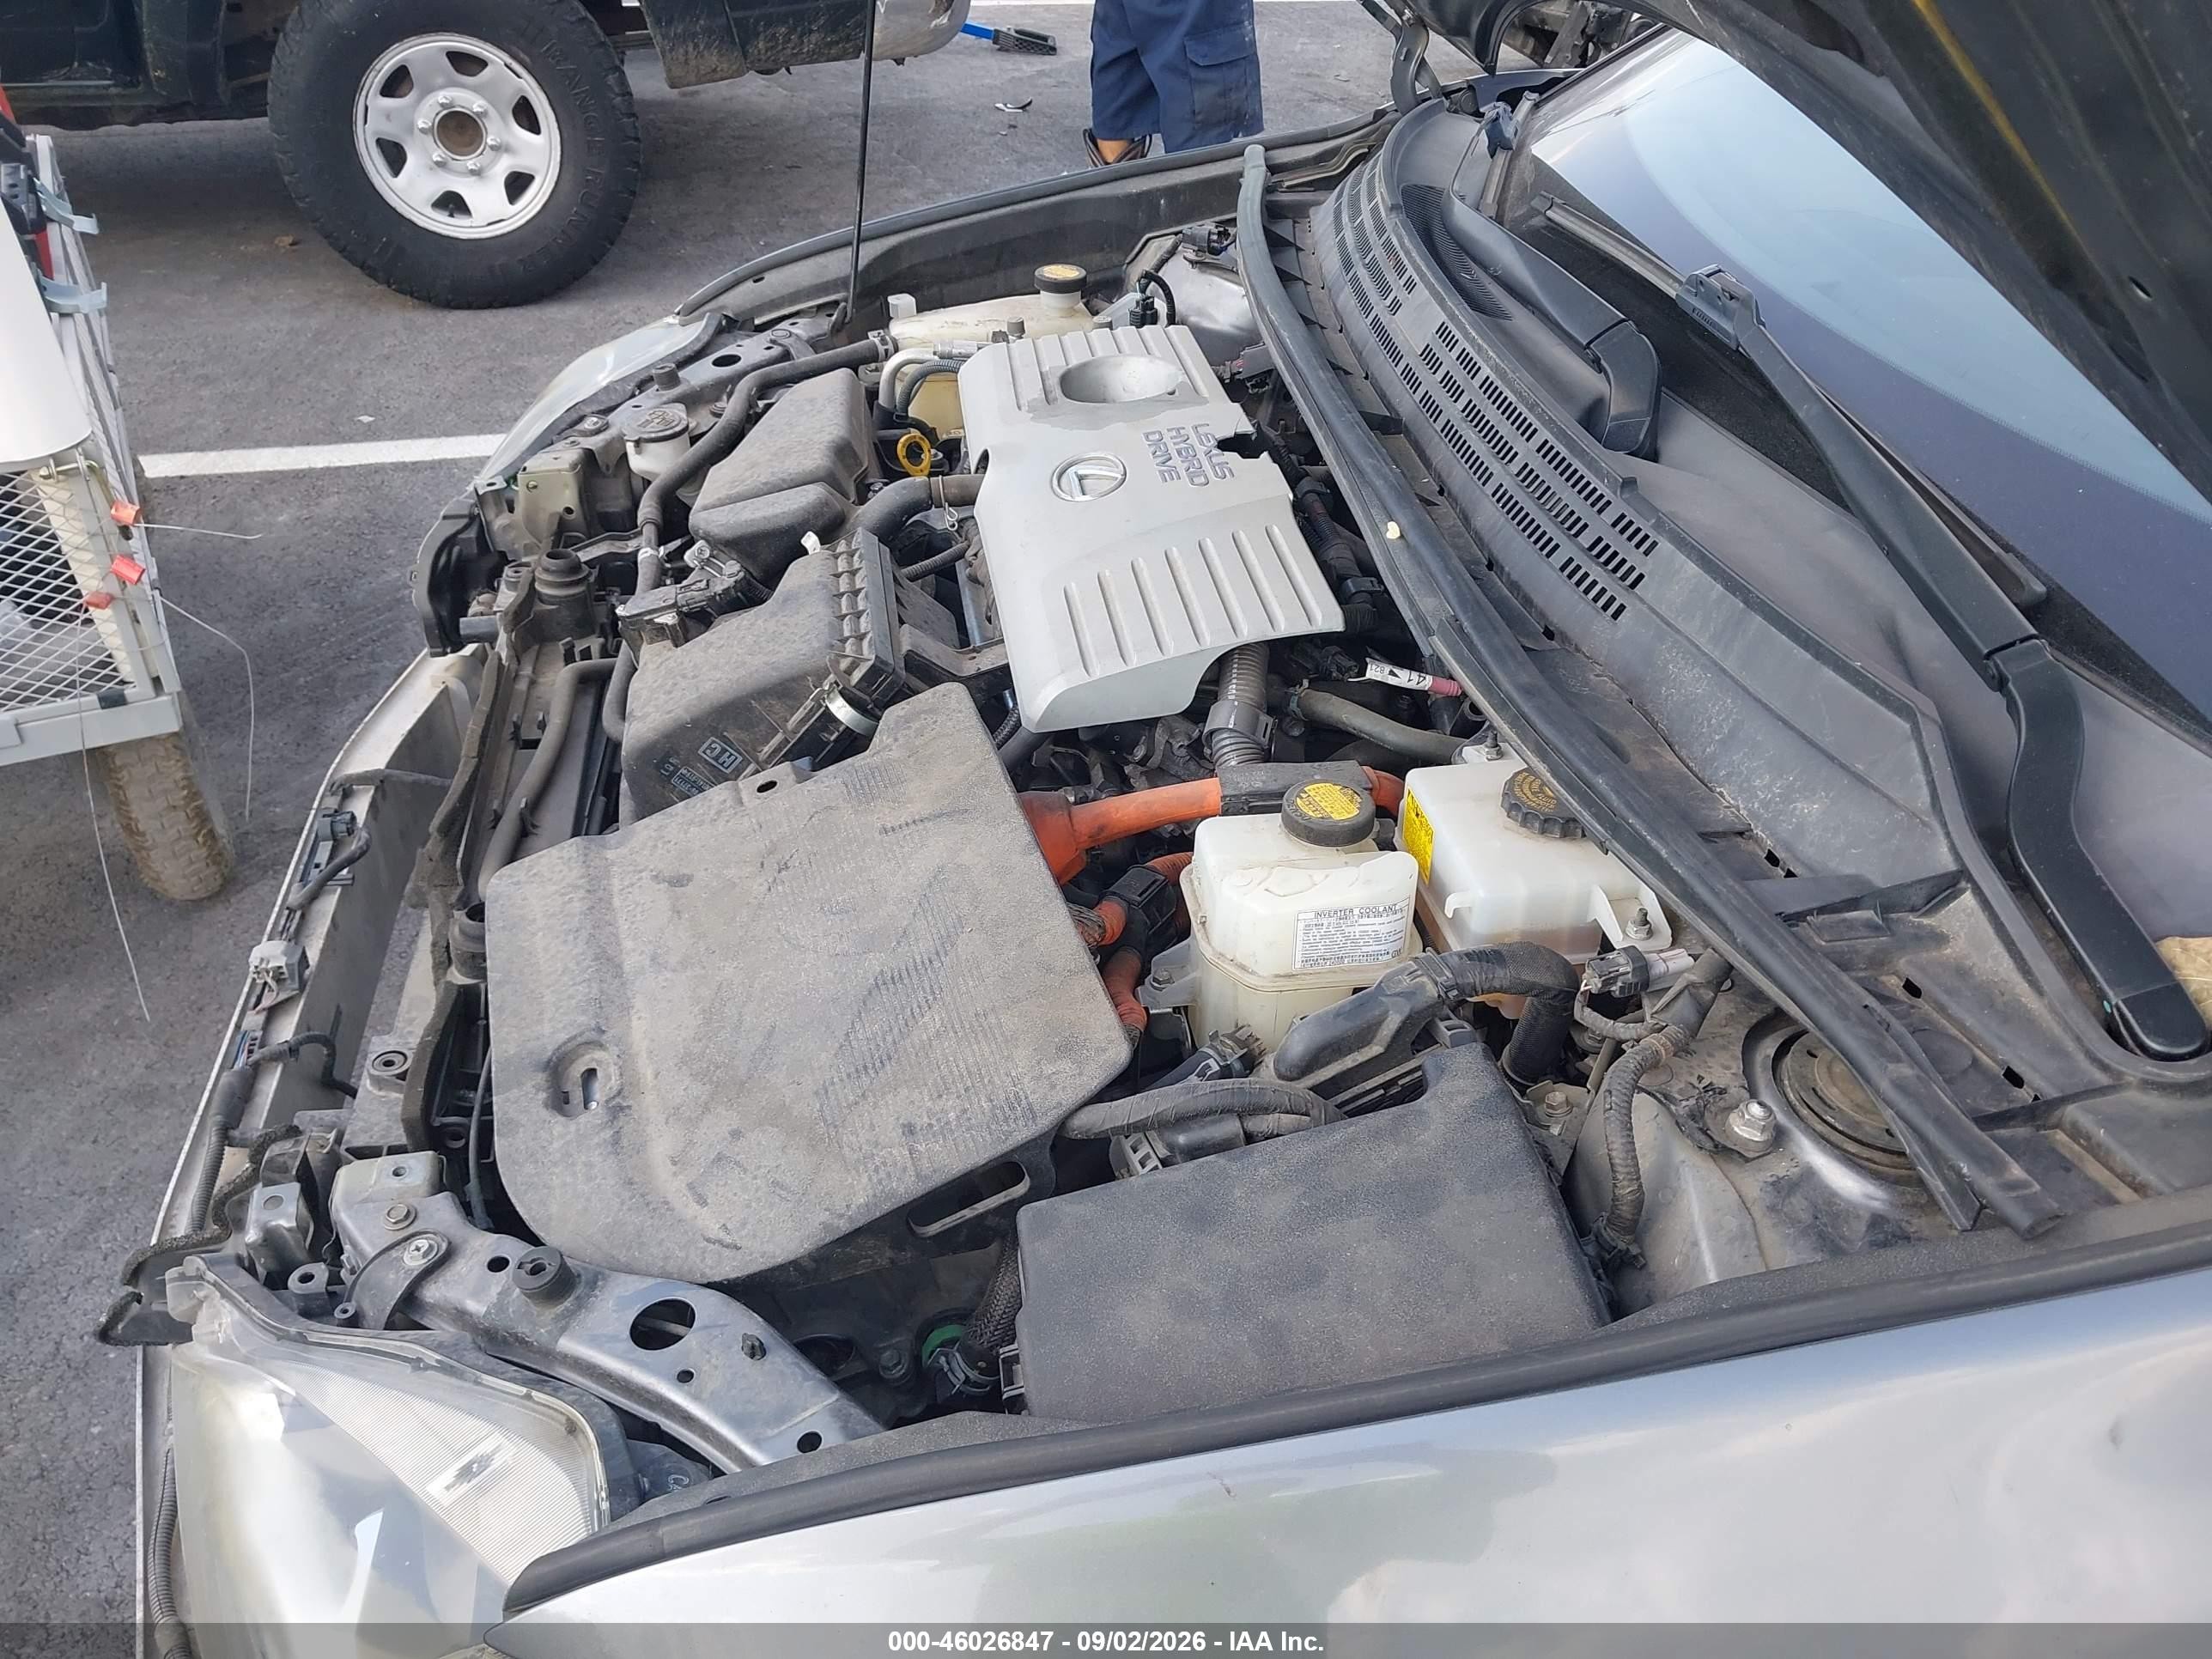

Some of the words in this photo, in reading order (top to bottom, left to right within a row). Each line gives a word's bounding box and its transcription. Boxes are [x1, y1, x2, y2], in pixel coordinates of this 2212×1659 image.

[1142, 429, 1182, 483] DRIVE
[1166, 426, 1210, 487] HYBRID
[1191, 422, 1235, 480] LEXUS
[1314, 908, 1354, 920] INVERTER
[1358, 903, 1398, 915] COOLANT
